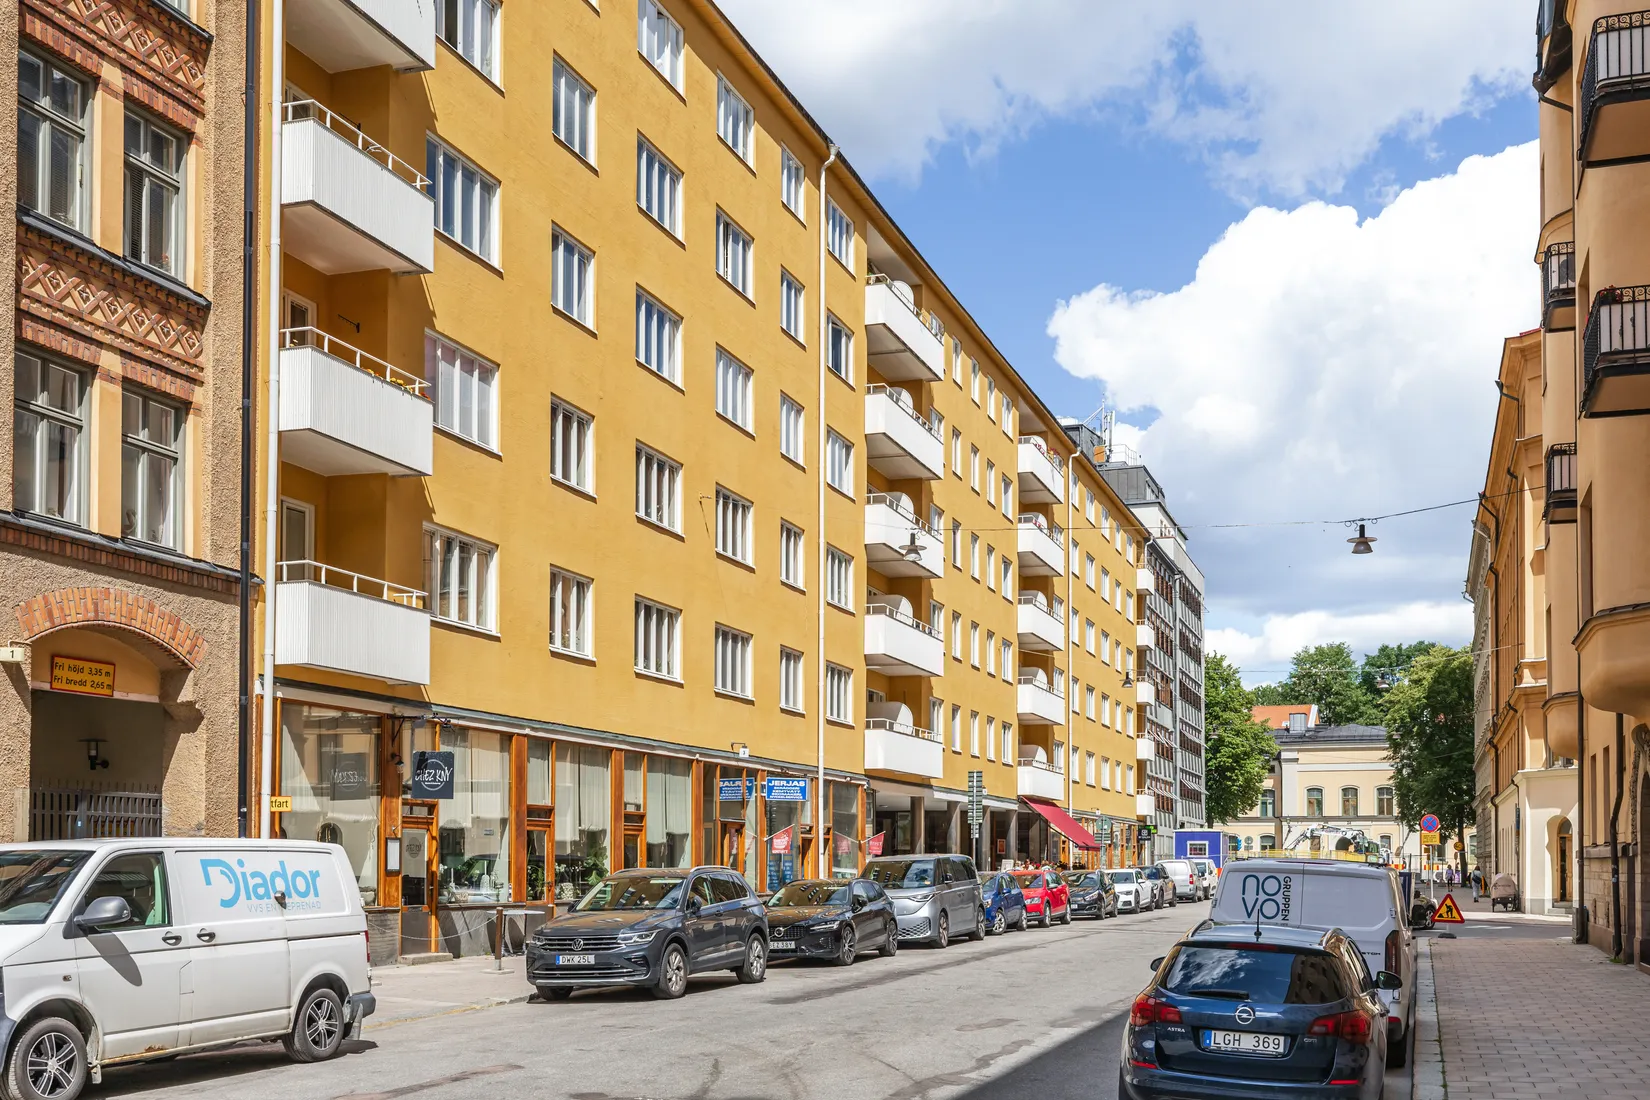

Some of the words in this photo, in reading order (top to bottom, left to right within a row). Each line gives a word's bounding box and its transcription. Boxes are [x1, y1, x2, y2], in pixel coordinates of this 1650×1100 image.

[10, 650, 14, 658] 1
[54, 662, 65, 671] Fri
[68, 664, 85, 674] höjd
[88, 667, 103, 677] 3,35
[53, 676, 63, 684] Fri
[66, 677, 87, 687] bredd
[90, 680, 105, 690] 2,65
[415, 769, 435, 781] CHEZ
[436, 766, 453, 782] KNY
[270, 798, 289, 808] tfart
[200, 858, 321, 908] Diador
[1281, 876, 1291, 921] GRUPPEN
[247, 903, 264, 913] VVS
[266, 901, 322, 912] ENTEPRENAD
[1213, 1033, 1241, 1047] LGH
[1252, 1035, 1281, 1050] 369
